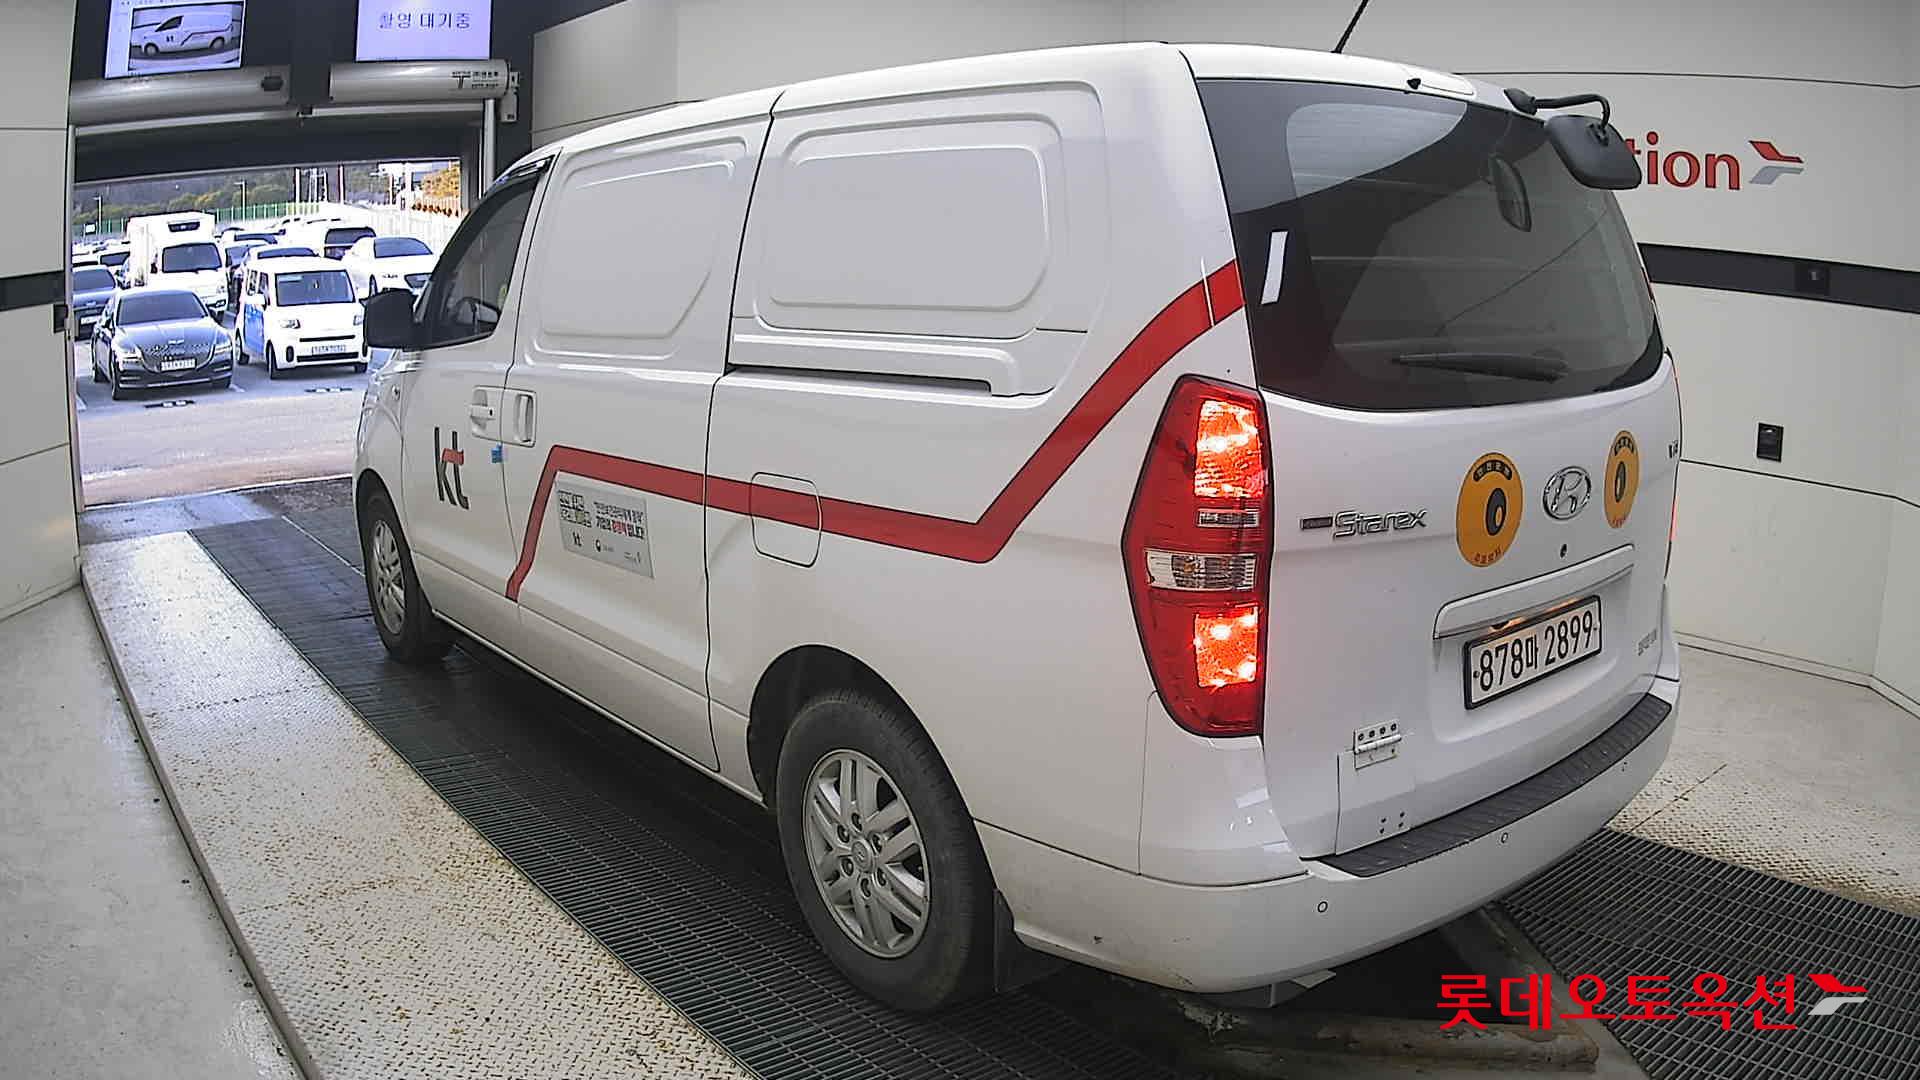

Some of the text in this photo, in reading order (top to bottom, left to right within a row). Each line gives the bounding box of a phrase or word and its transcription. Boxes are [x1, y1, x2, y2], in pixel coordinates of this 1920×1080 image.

[420, 12, 471, 29] 대기중
[434, 426, 470, 510] kt
[1333, 509, 1428, 542] Starex
[1479, 634, 1540, 692] 878마
[1544, 610, 1594, 666] 2899
